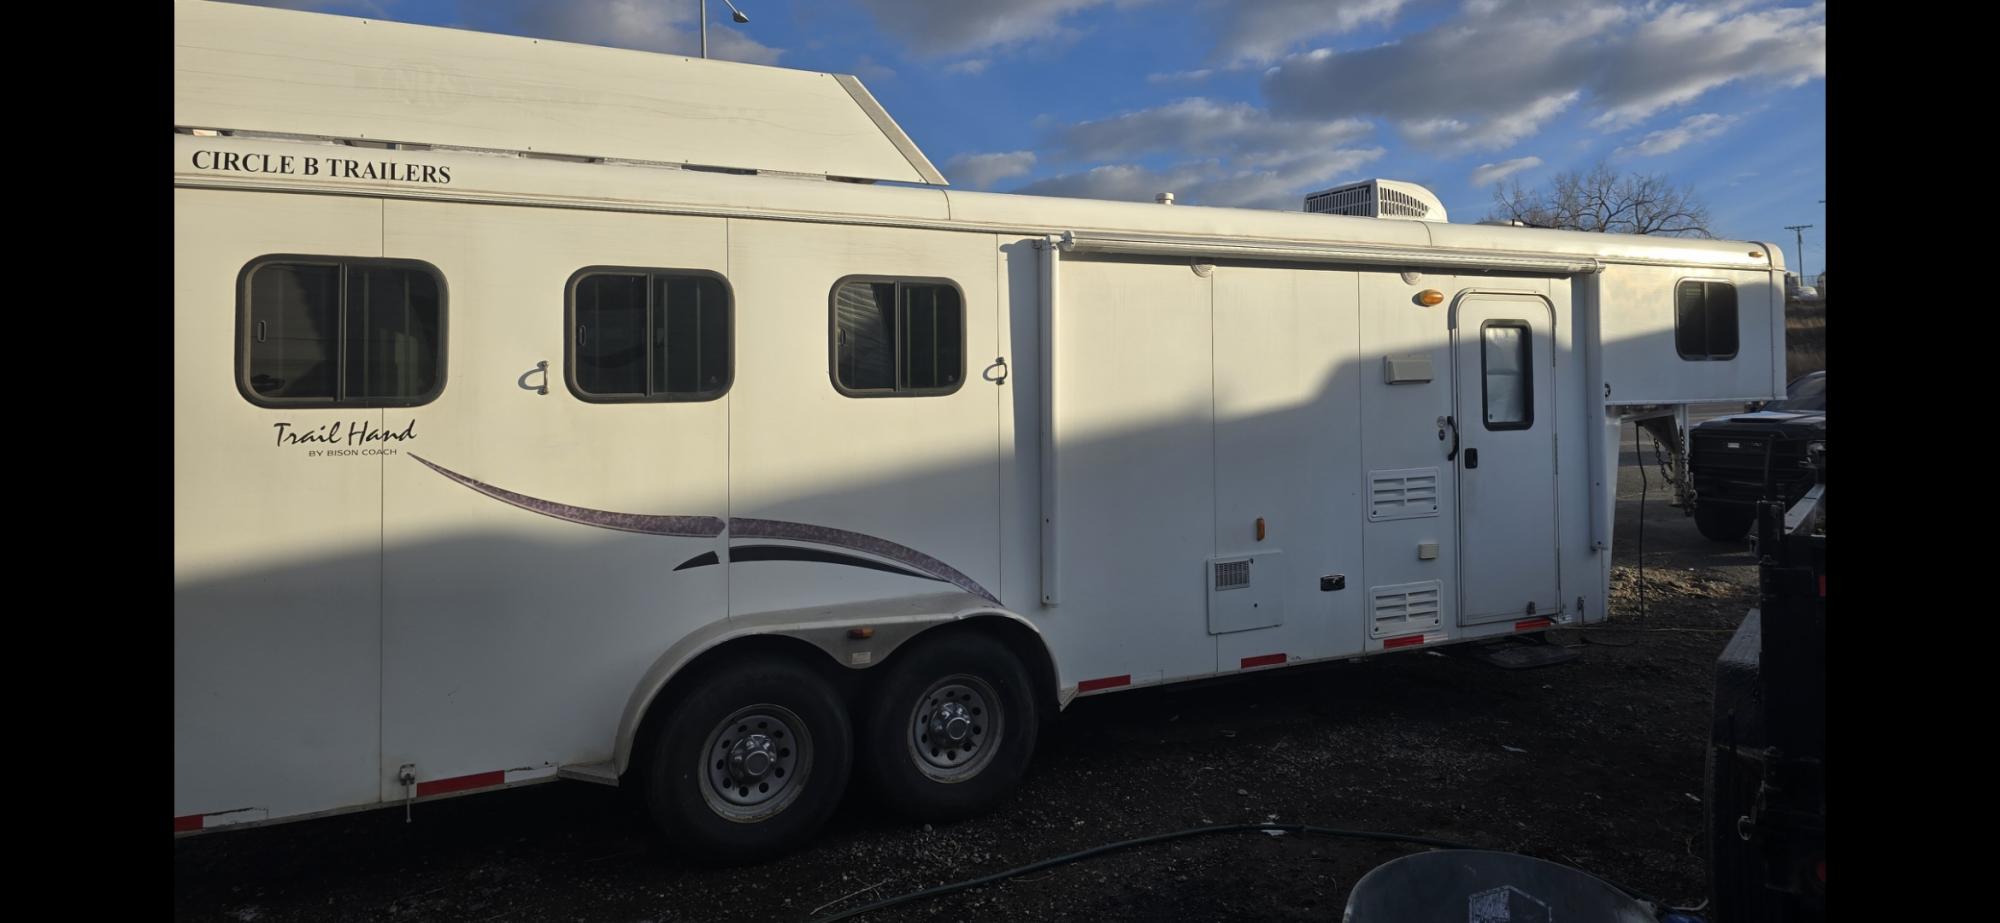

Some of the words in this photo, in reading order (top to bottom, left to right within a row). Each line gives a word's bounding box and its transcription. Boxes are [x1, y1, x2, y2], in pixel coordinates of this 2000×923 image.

[191, 150, 295, 175] CIRCLE
[303, 156, 319, 176] B
[326, 158, 451, 184] TRAILERS
[273, 421, 342, 448] Trail
[348, 418, 418, 448] Hand
[326, 449, 359, 457] BISON
[361, 448, 397, 456] COACH
